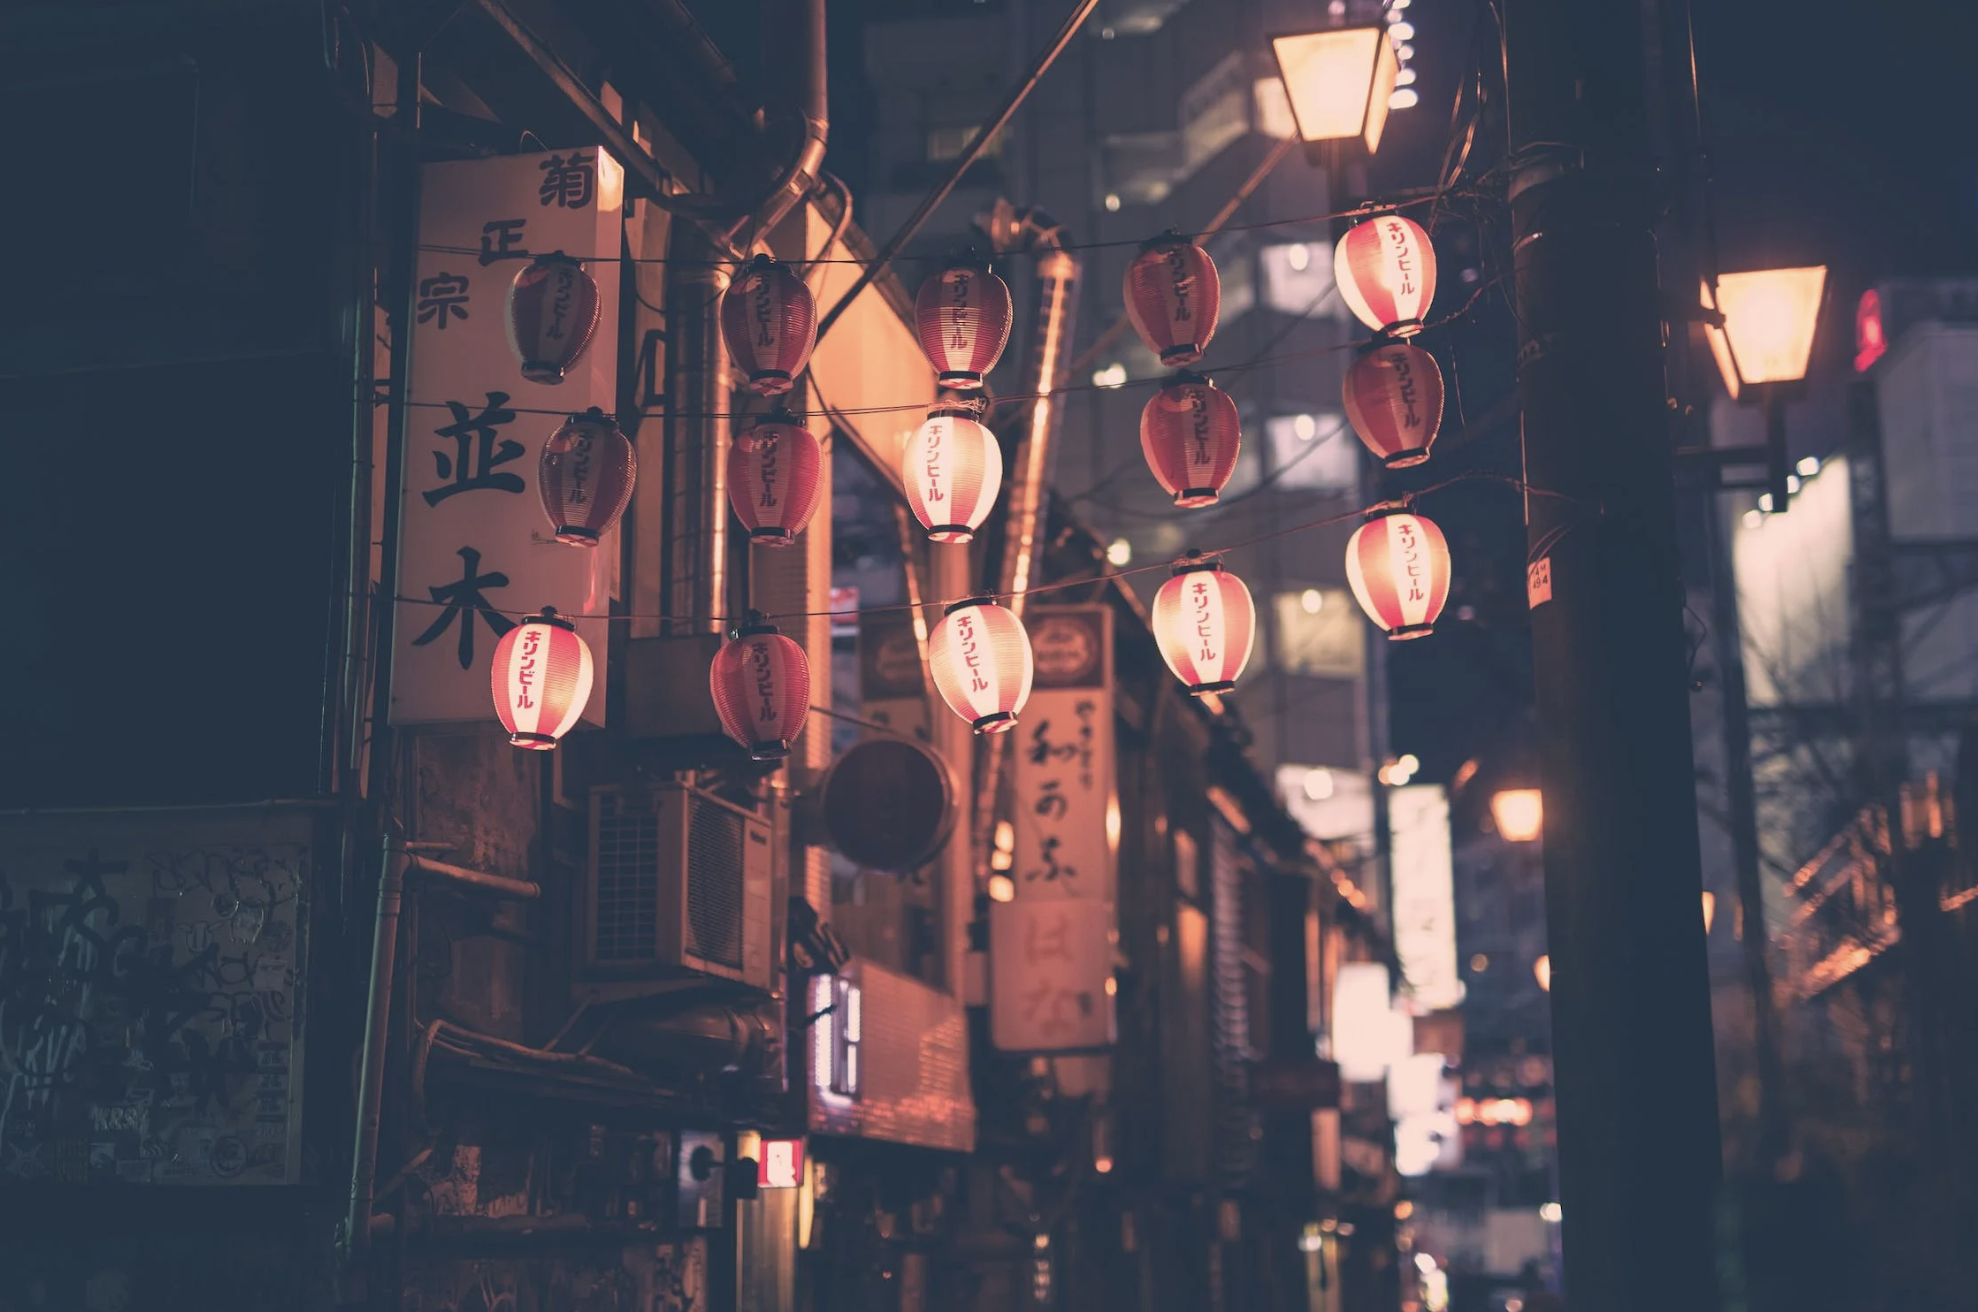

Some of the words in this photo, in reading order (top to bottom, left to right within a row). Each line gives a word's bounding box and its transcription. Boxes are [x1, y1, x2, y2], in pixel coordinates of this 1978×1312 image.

[418, 153, 594, 329] 菊正宗
[413, 391, 525, 670] 並木
[517, 631, 541, 709] キリンビール
[753, 643, 777, 722] キリンビール
